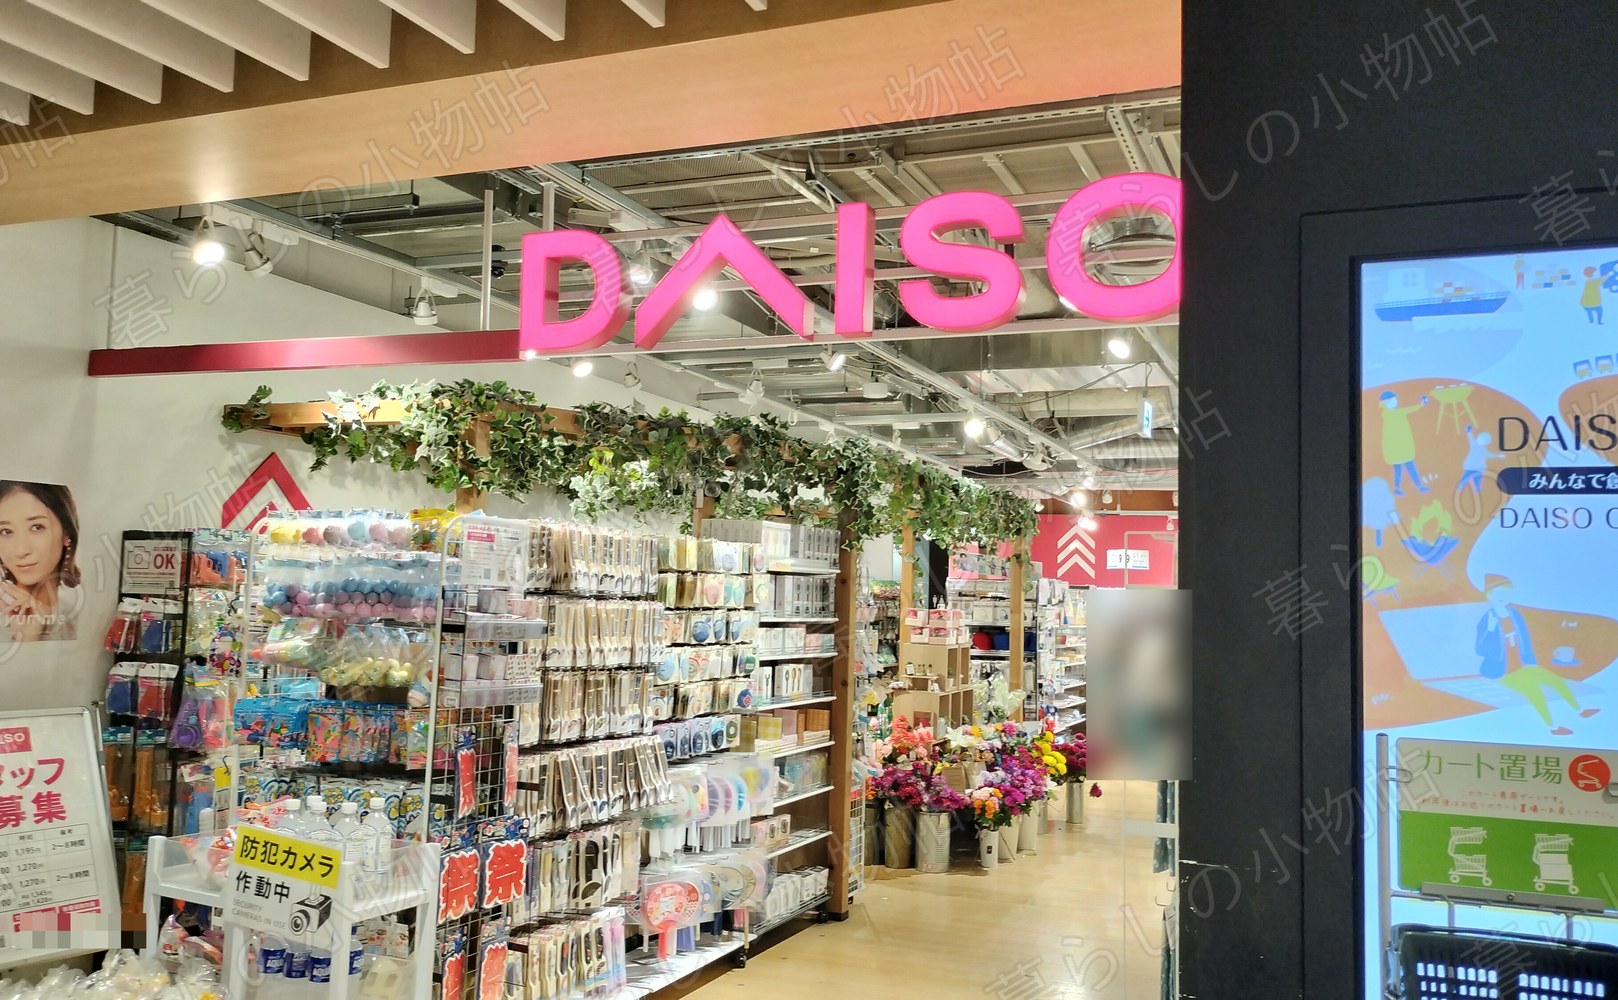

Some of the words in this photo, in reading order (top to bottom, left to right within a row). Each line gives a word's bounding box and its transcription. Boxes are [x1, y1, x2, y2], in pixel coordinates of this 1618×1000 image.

[520, 173, 1182, 358] DAISO
[1498, 414, 1618, 452] DAIS
[1500, 507, 1593, 529] DAISO
[153, 553, 175, 570] OK
[0, 757, 65, 789] ッフ
[1419, 750, 1562, 785] カート置場
[240, 835, 334, 878] 防犯カメラ
[485, 840, 526, 907] 祭
[235, 870, 290, 904] 作動中
[439, 850, 480, 922] 祭
